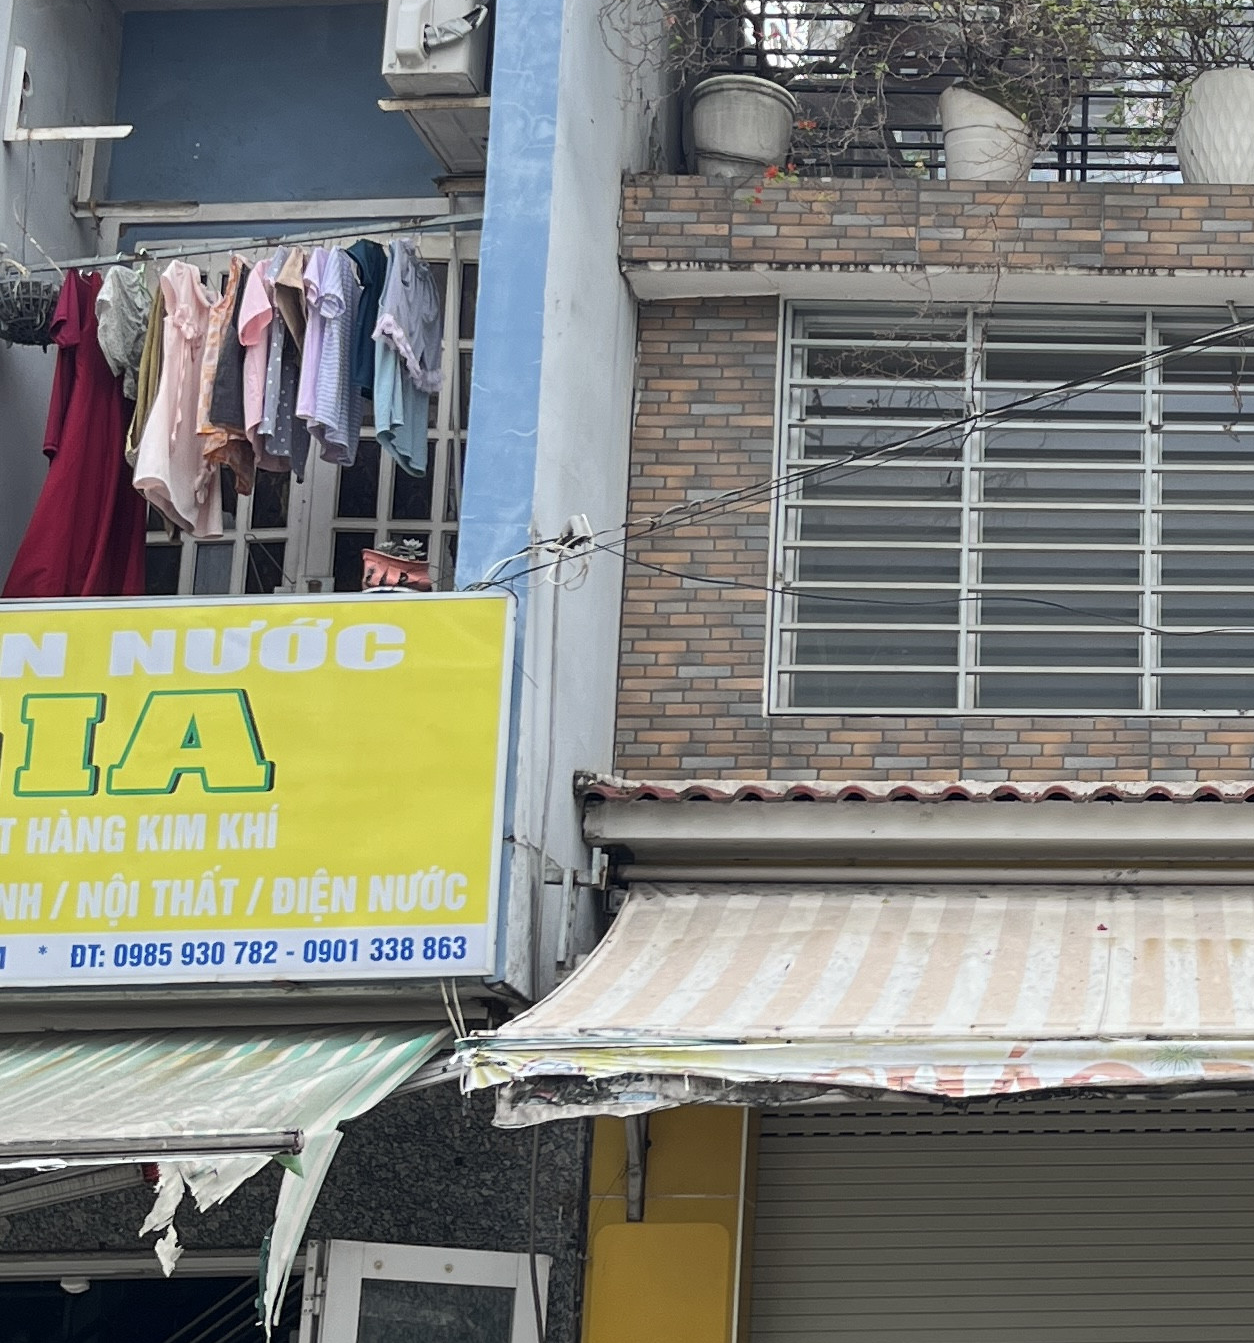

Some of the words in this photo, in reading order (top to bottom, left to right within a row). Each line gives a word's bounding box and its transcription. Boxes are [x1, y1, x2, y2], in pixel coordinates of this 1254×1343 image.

[110, 617, 406, 677] NƯỚC
[0, 688, 276, 798] IA
[25, 808, 127, 855] HÀNG
[136, 812, 207, 854] KIM
[216, 803, 280, 851] KHÍ
[75, 872, 141, 928] NỘI
[152, 864, 240, 918] THẤT
[271, 867, 358, 923] ĐIỆN
[368, 865, 468, 914] NƯỚC
[70, 943, 105, 969] ĐT:
[113, 942, 174, 968] 0985
[181, 941, 226, 966] 930
[233, 940, 279, 965] 782
[302, 938, 360, 964] 0901
[369, 937, 415, 962] 338
[422, 935, 468, 961] 863
